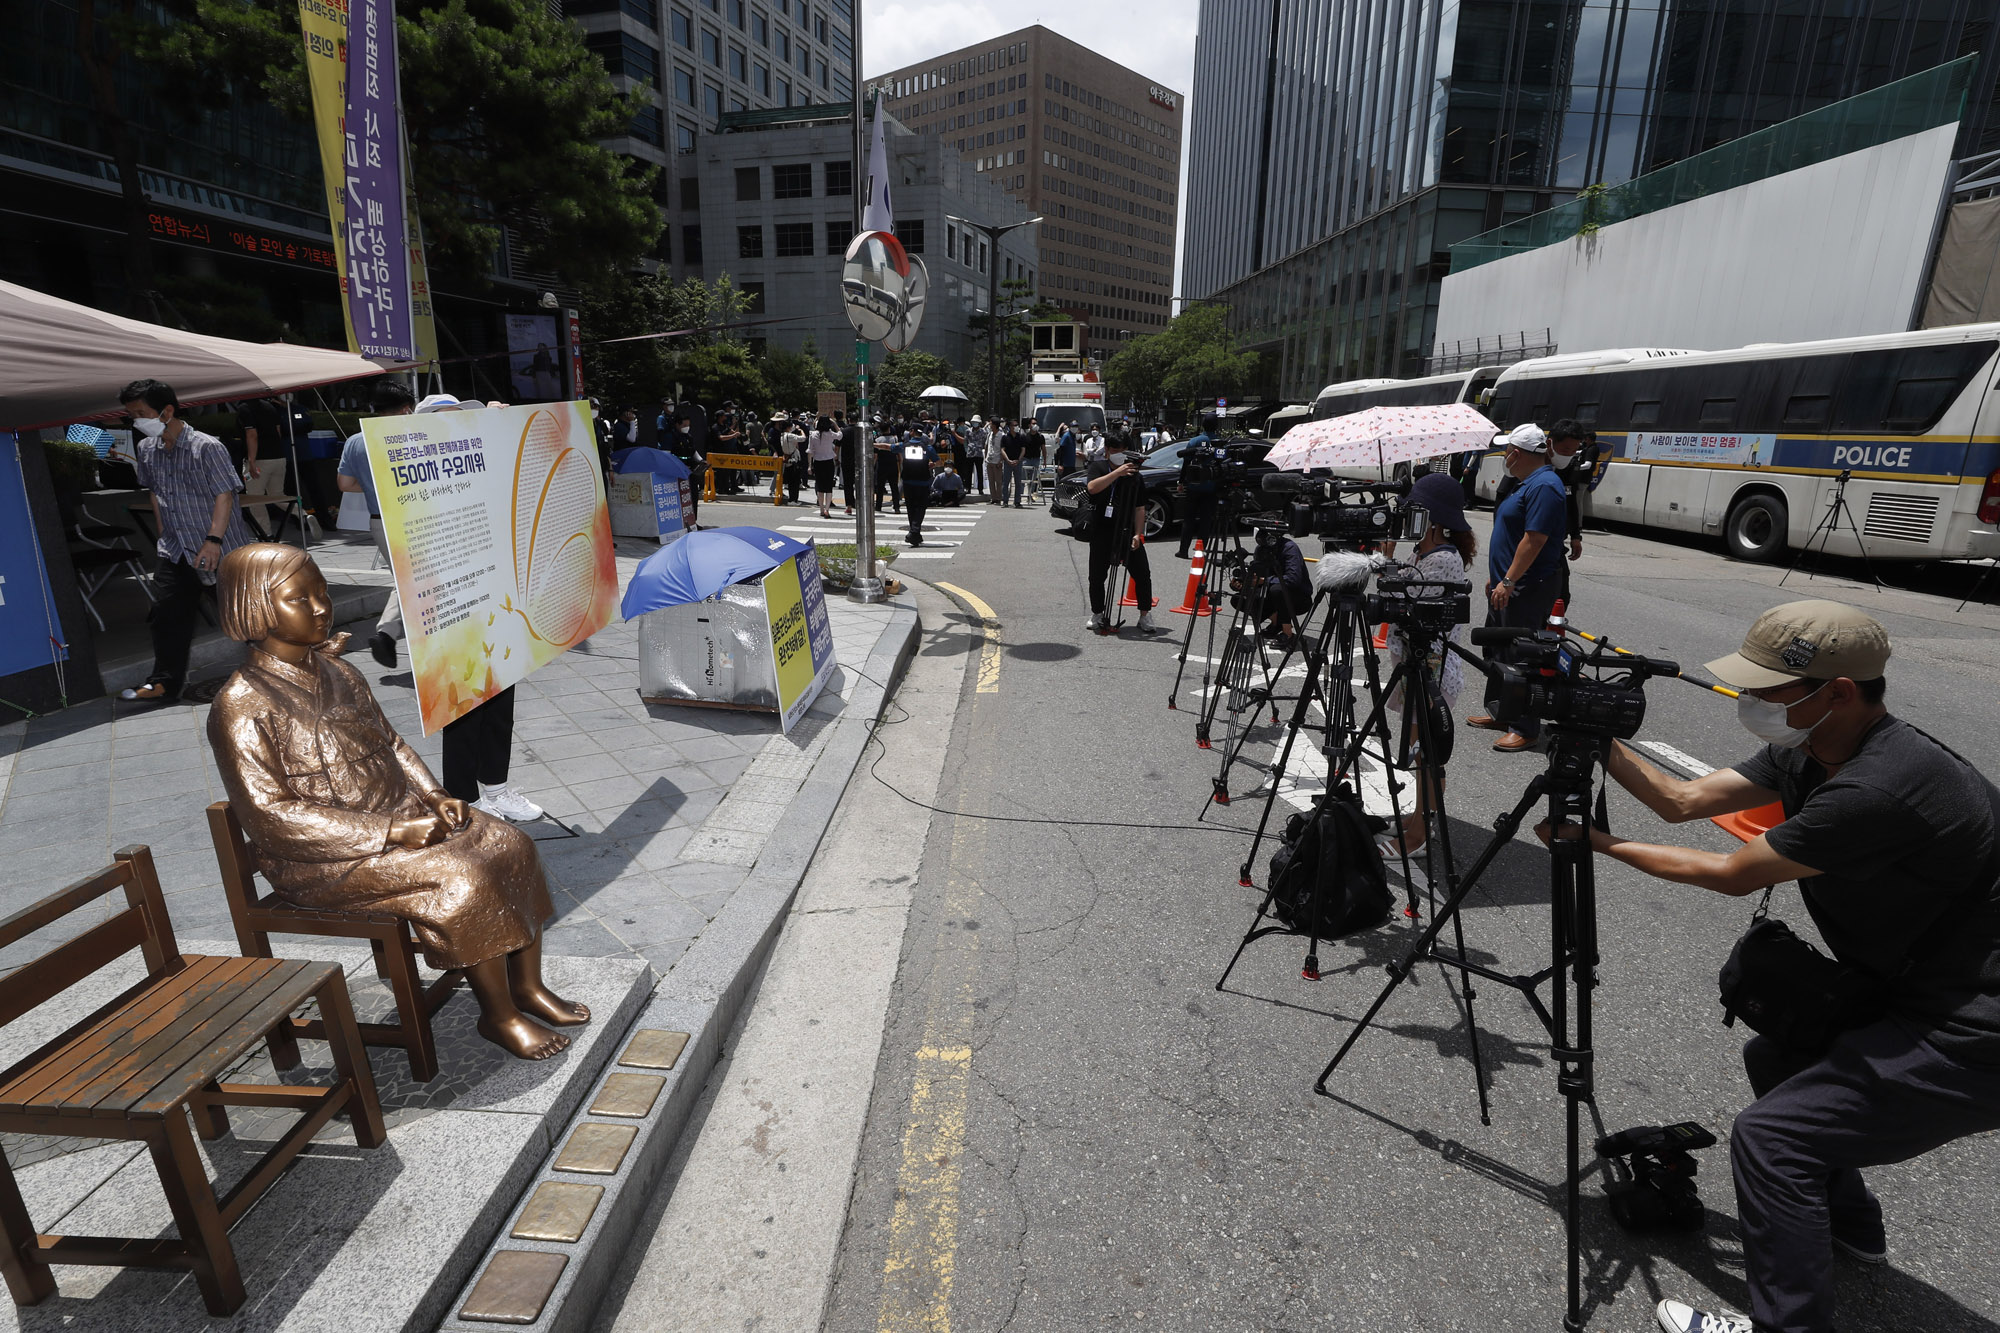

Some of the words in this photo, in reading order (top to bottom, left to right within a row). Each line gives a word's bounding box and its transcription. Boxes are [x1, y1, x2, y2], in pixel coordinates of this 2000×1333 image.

[1150, 86, 1176, 107] 아주경제
[149, 213, 211, 243] 연합뉴스]
[260, 238, 283, 257] 모인
[384, 434, 408, 444] 1500인이
[408, 431, 428, 441] 주관하는
[1650, 435, 1672, 446] 사람이
[1674, 435, 1698, 447] 보이면
[1700, 436, 1717, 448] 일단
[1720, 436, 1742, 448] 멈춤!
[387, 443, 438, 462] 일본군성노예제
[438, 438, 470, 454] 문제해결을
[470, 437, 483, 449] 위한
[1832, 446, 1912, 467] POLICE
[390, 460, 440, 486] 1500차
[442, 452, 486, 478] 수요시위
[730, 458, 757, 466] POLICE
[1439, 706, 1449, 732] Canon
